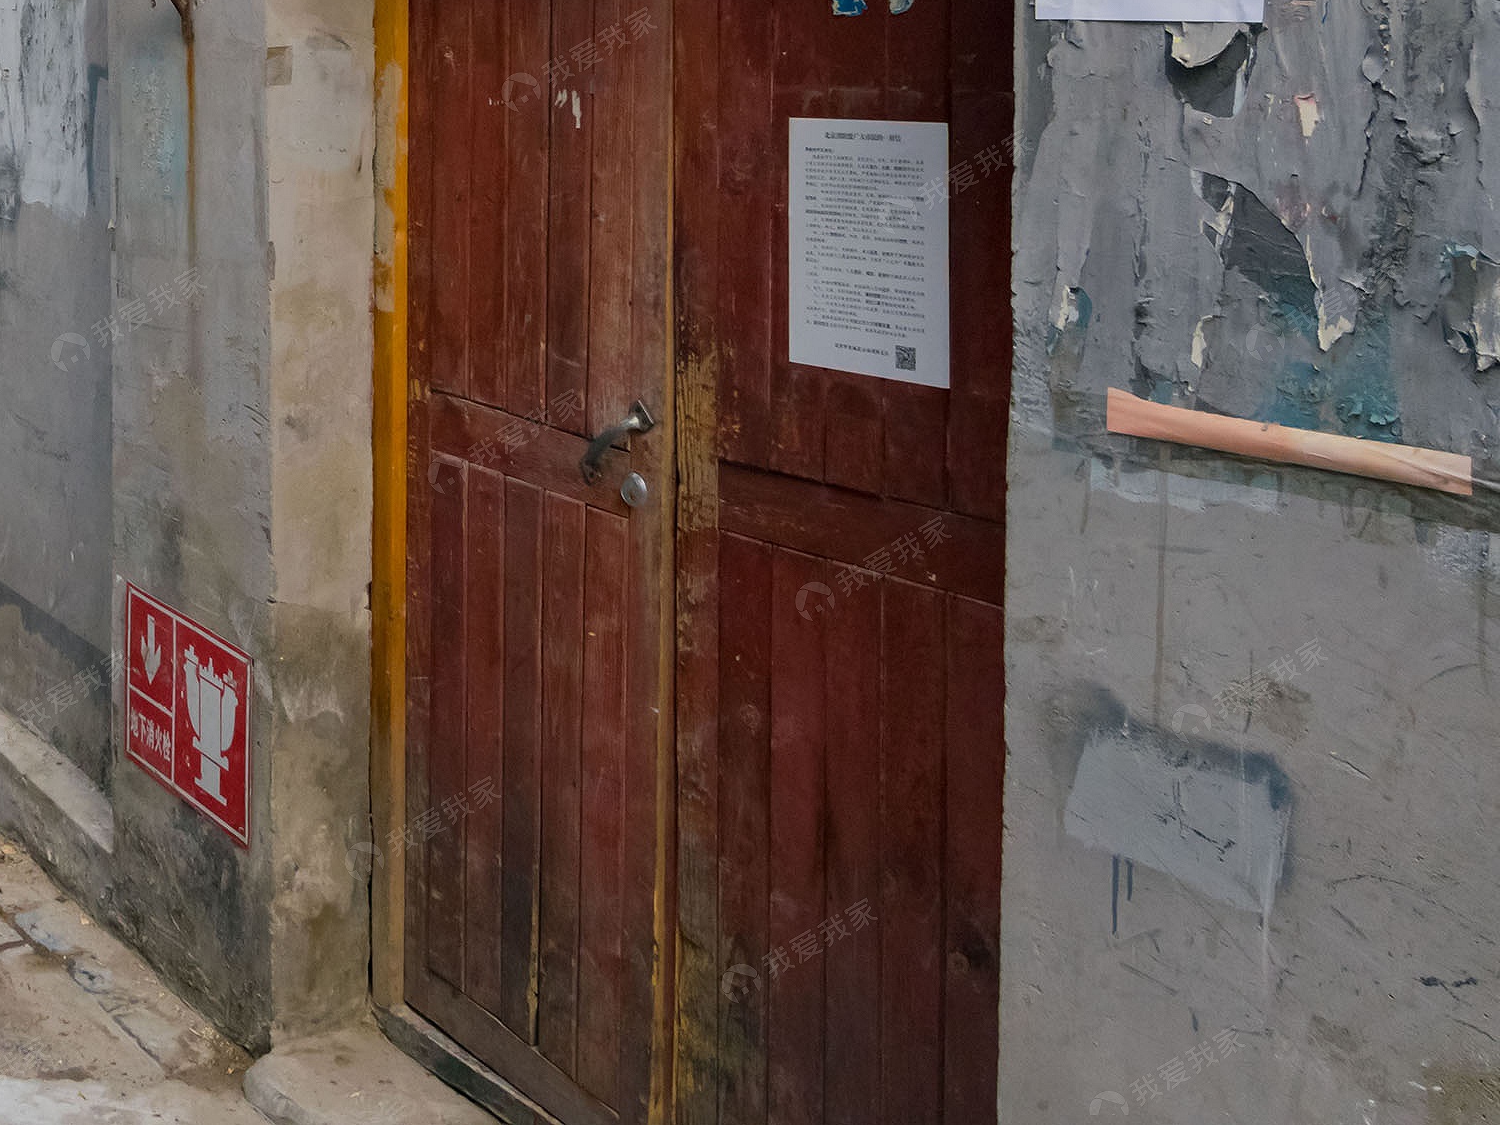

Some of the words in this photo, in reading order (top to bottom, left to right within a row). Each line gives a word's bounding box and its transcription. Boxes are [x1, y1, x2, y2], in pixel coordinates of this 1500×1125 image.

[130, 707, 172, 763] 地下消火栓
